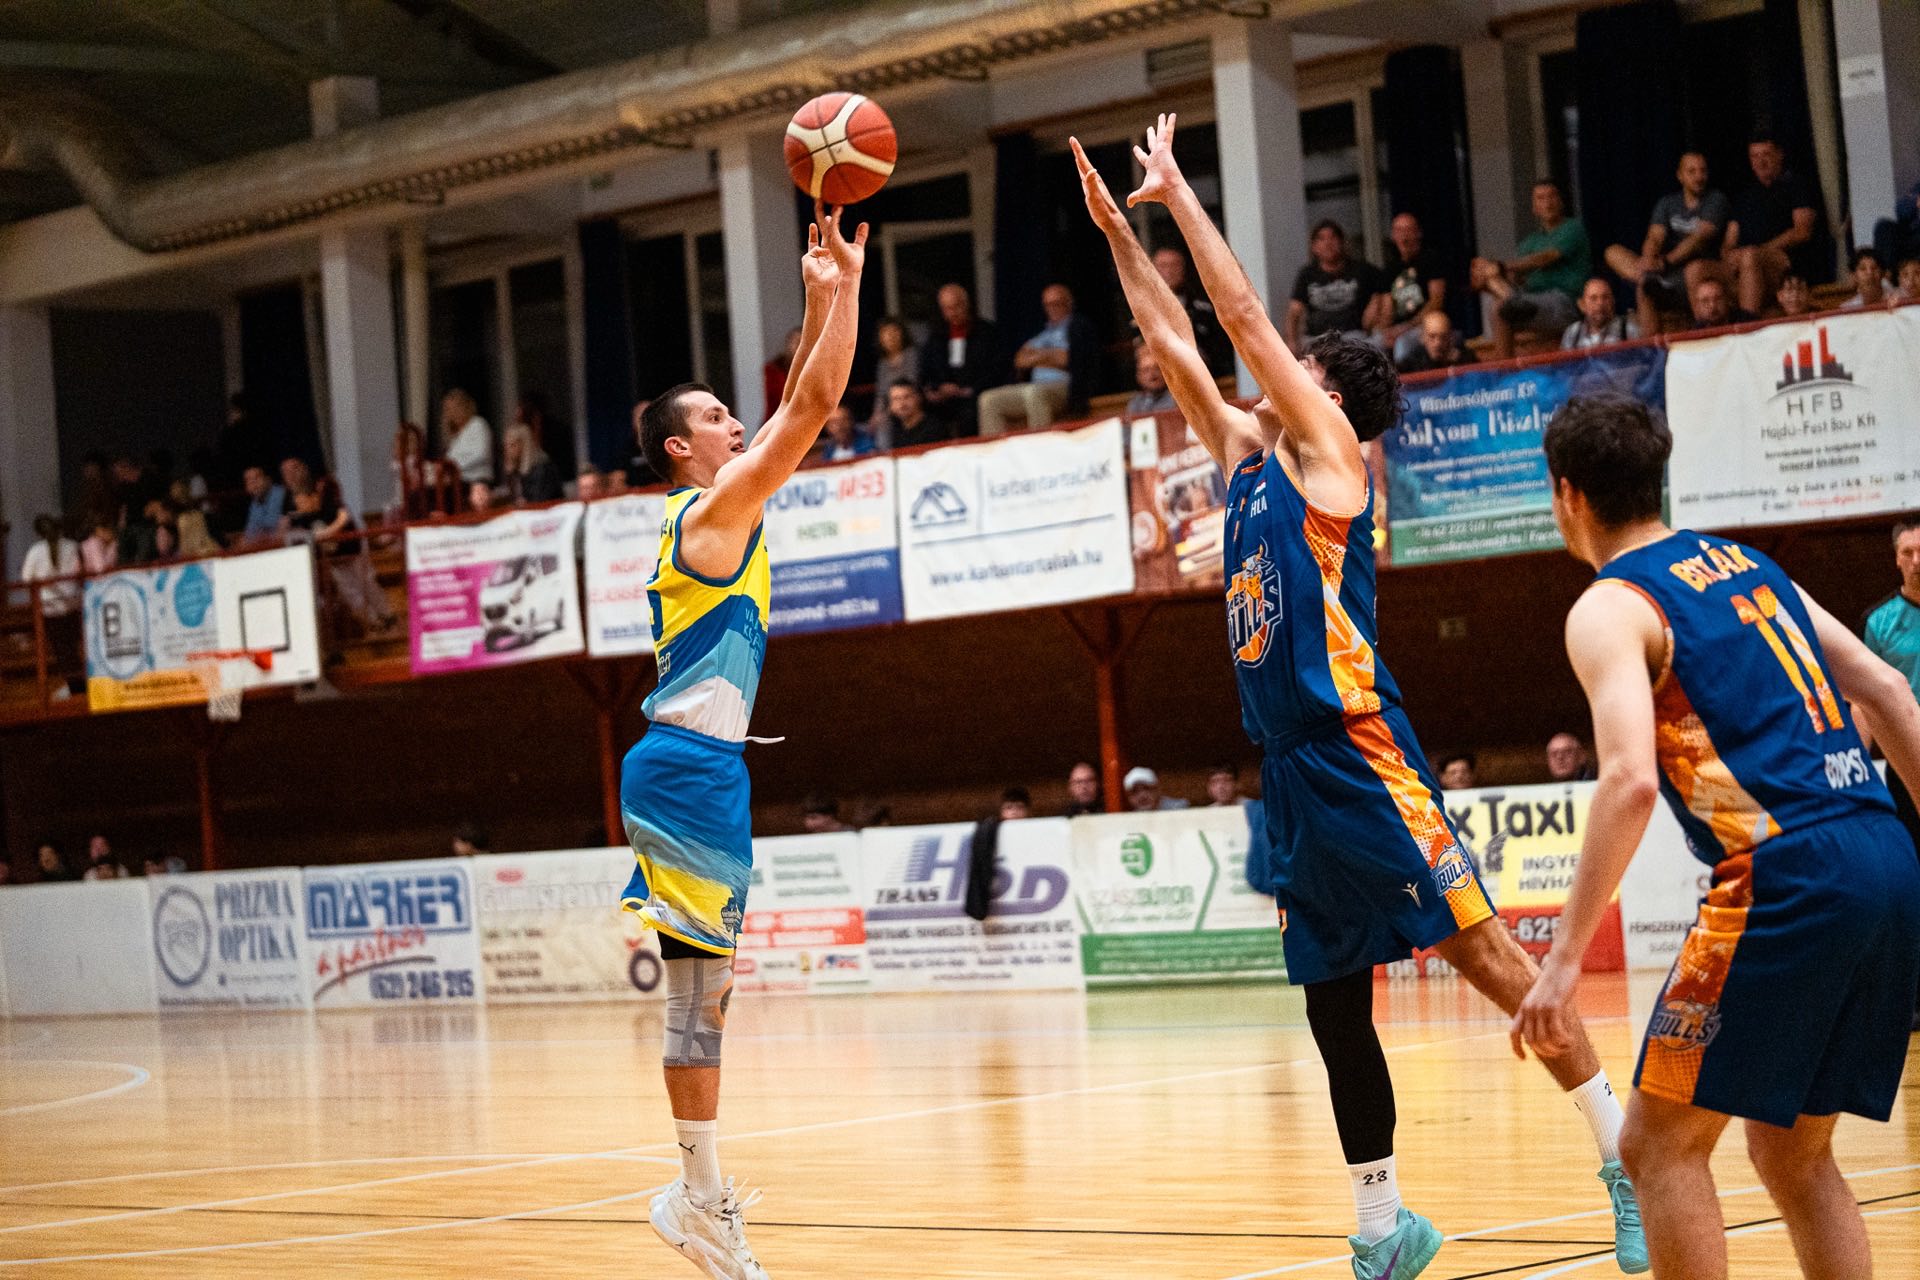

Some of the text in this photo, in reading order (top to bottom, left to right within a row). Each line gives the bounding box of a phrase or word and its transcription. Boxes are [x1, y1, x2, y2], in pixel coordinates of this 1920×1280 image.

[1730, 584, 1845, 734] 11
[214, 880, 296, 921] PRIZMA
[309, 875, 463, 929] MARKER
[875, 885, 941, 905] TRANS
[218, 924, 297, 961] OPTIKA
[1363, 1170, 1388, 1185] 23
